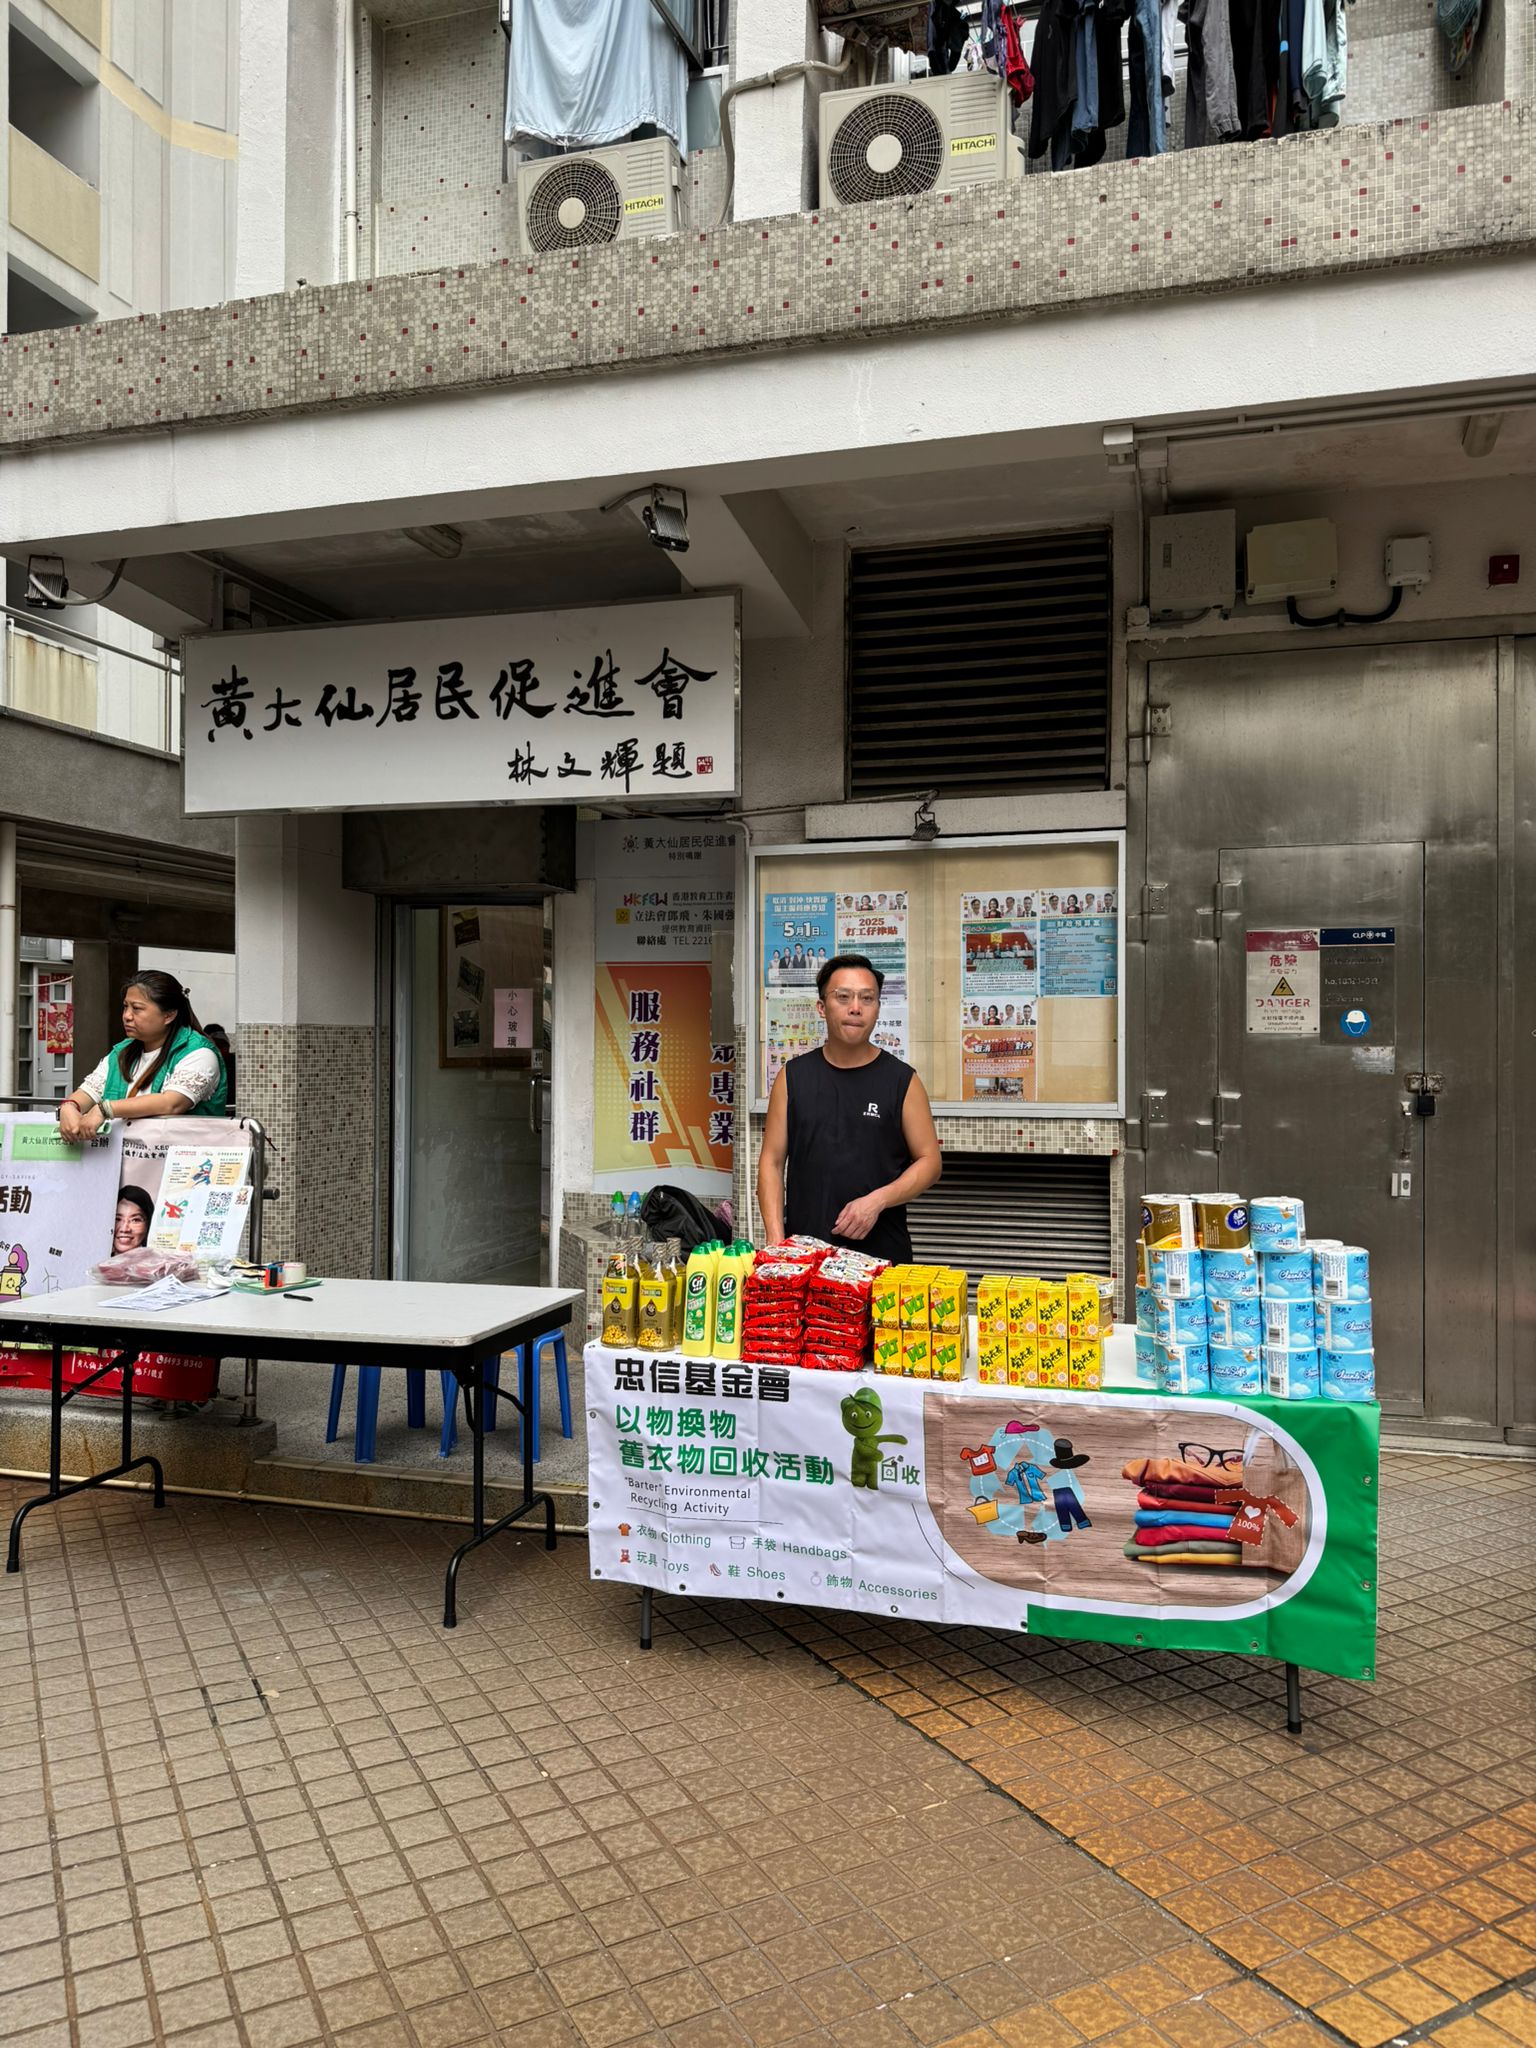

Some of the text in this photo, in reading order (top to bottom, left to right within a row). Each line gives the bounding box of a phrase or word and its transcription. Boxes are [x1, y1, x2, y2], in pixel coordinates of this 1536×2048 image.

[952, 137, 995, 151] HITACHI
[625, 195, 664, 211] HITACHI
[201, 648, 717, 743] 黃大仙居民促進會
[507, 738, 692, 793] 林文輝題
[672, 891, 735, 902] 香港教育工作者
[859, 918, 885, 926] 2025
[672, 936, 690, 945] TEL
[1256, 998, 1311, 1008] DANGER
[507, 991, 518, 1047] 小心玻璃
[629, 990, 661, 1143] 服務社群
[868, 1102, 878, 1113] R
[692, 1276, 704, 1288] Cif
[721, 1278, 734, 1290] Cif
[613, 1358, 791, 1403] 忠信基金會
[615, 1404, 737, 1440] 以物換物
[618, 1439, 835, 1486] 舊衣物回收活動
[664, 1485, 751, 1499] Environmental
[630, 1492, 730, 1516] Recycling Activity
[1237, 1518, 1261, 1532] 100%
[636, 1523, 712, 1549] 衣物 Clothing
[752, 1537, 848, 1561] 手袋 Handbags
[637, 1551, 690, 1574] 玩具 Toys
[727, 1564, 786, 1580] 鞋 Shoes
[826, 1574, 938, 1600] 飾物 Accessories
